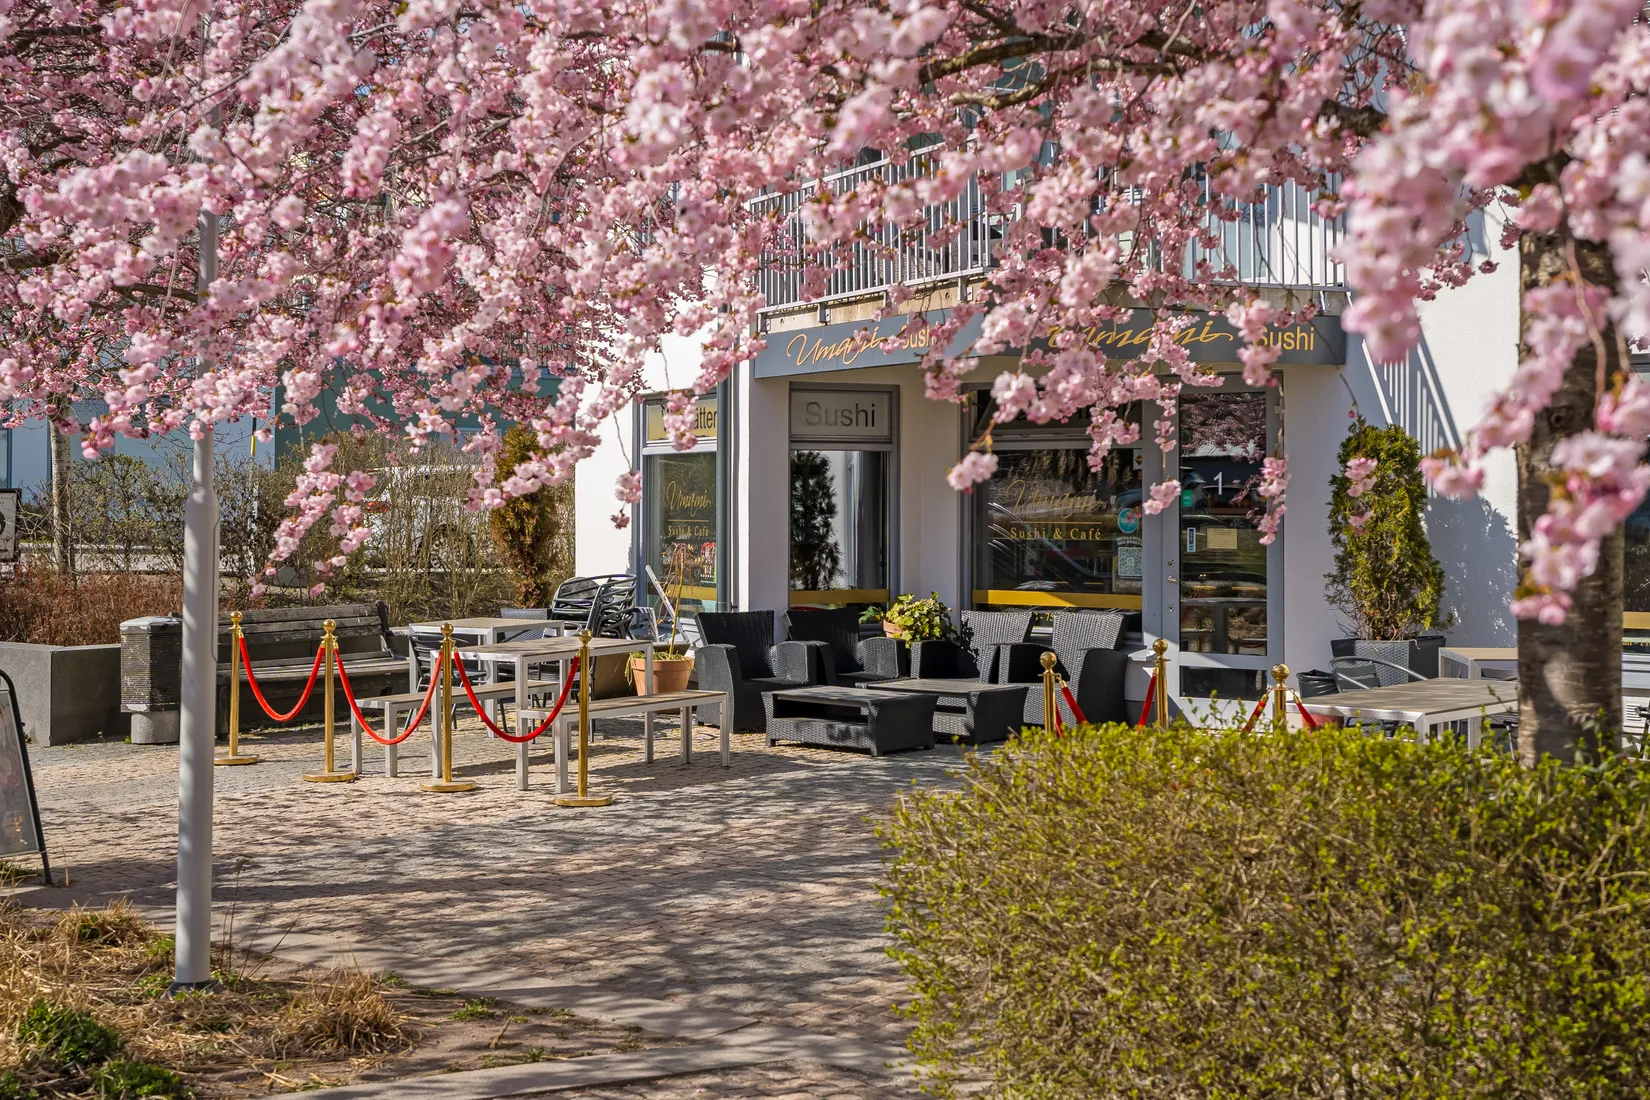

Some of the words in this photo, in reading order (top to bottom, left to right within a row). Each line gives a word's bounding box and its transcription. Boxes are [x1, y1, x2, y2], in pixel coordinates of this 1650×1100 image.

[804, 401, 876, 428] Sushi
[1213, 471, 1223, 495] 1
[1010, 527, 1046, 540] Sushi
[1053, 527, 1063, 540] &
[1070, 526, 1102, 540] Café
